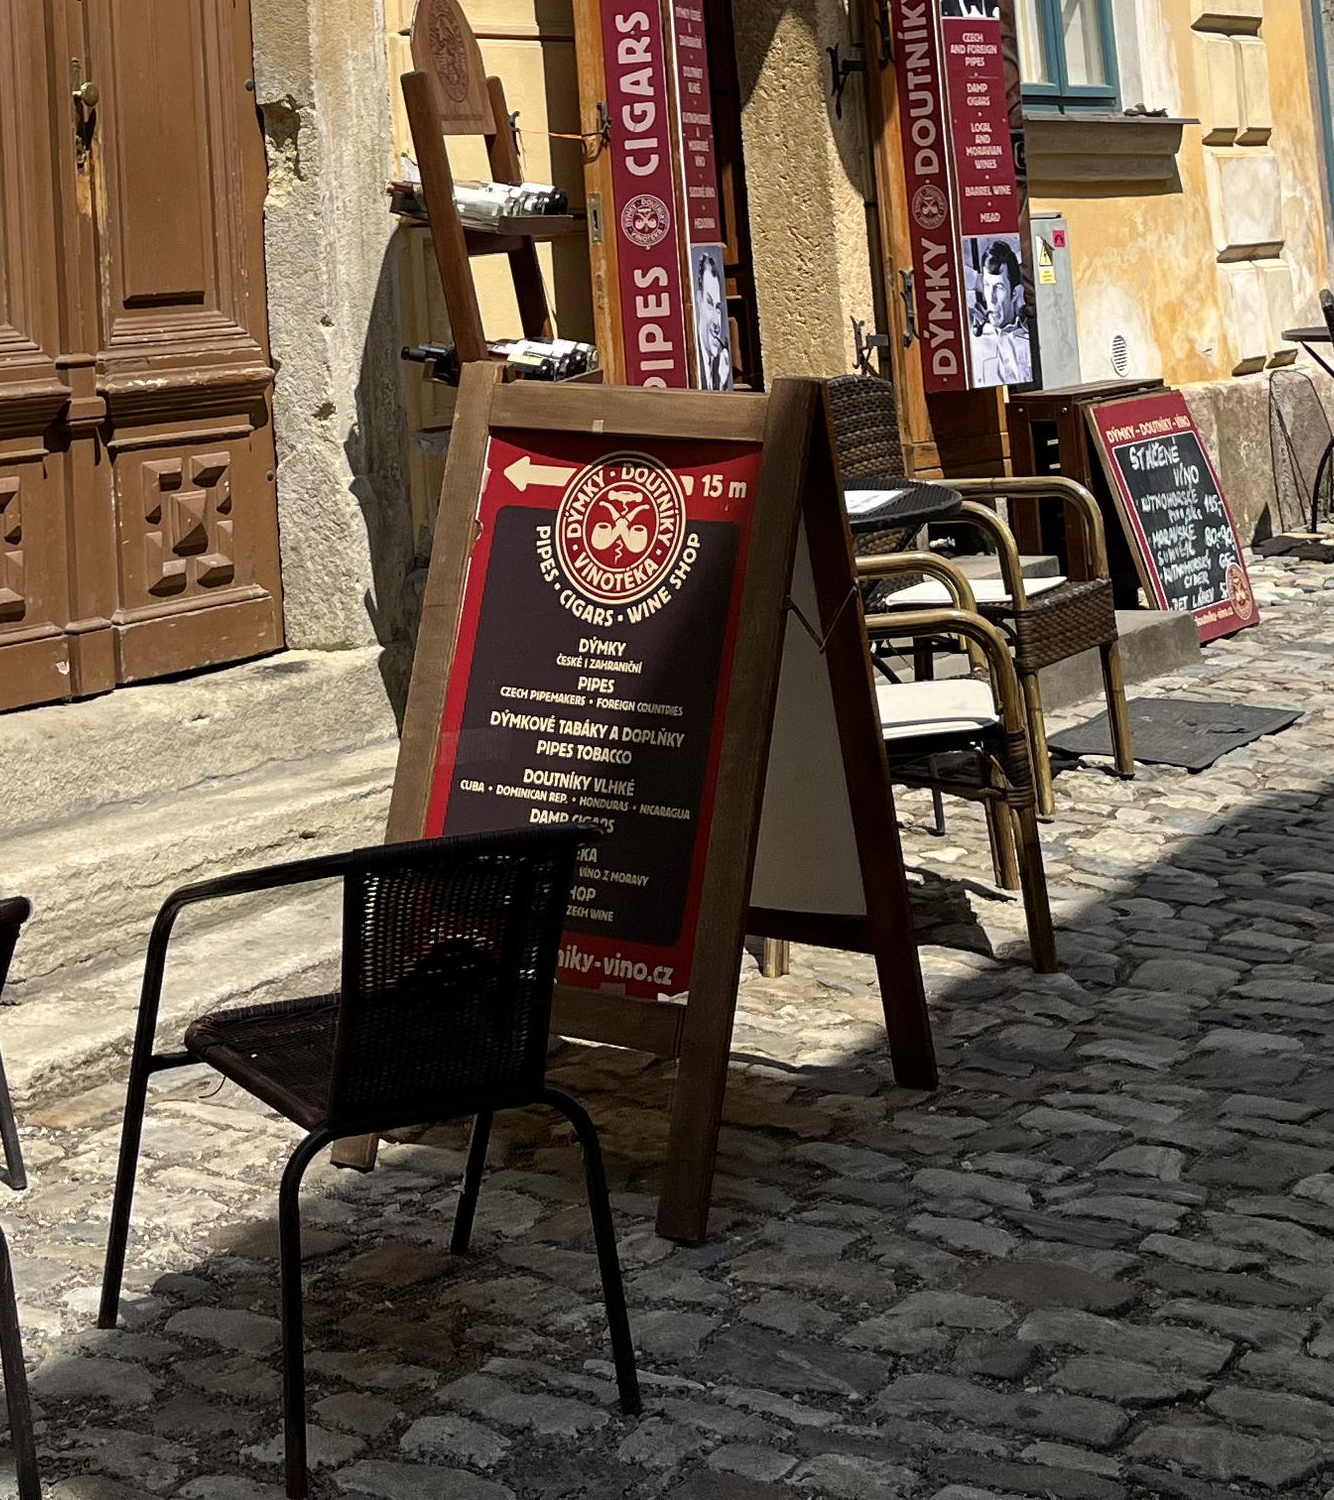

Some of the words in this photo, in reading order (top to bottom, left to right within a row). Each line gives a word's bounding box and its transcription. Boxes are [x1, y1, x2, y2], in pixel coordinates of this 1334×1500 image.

[950, 44, 966, 54] AND
[614, 10, 662, 177] CIGARS
[966, 83, 988, 93] DAMP
[975, 134, 991, 145] AND
[993, 186, 1012, 196] WINE
[980, 213, 1001, 223] MEAD
[920, 237, 958, 376] DÝMKY
[633, 266, 675, 388] PIPES
[1105, 426, 1136, 444] DÝMKY
[700, 473, 725, 499] 15
[727, 480, 748, 500] m
[1172, 461, 1200, 488] VÍNO
[564, 468, 606, 539] DÝMKY
[621, 463, 680, 547] DOUTNÍKY
[535, 525, 560, 584] PIPES
[559, 589, 615, 628] CIGARS
[626, 586, 673, 624] WINE
[669, 532, 701, 590] SHOP
[572, 556, 659, 592] VINOTÉKA
[578, 636, 627, 658] DÝMKY
[556, 653, 583, 668] ČESKÉ
[589, 657, 643, 674] ZAHRANIČNÍ
[577, 676, 616, 694] PIPES
[500, 686, 529, 700] CZECH
[529, 688, 586, 706] PIPEMAKERS
[596, 697, 636, 712] FOREIGN
[636, 702, 684, 717] COUNTRIES
[490, 710, 556, 733] DÝMKOVÉ
[559, 718, 609, 740] TABÁKY
[608, 725, 619, 740] A
[621, 727, 685, 748] DOPLŇKY
[536, 739, 574, 758] PIPES
[576, 744, 633, 765] TOBACCO
[523, 768, 592, 791] DOUTNÍKY
[593, 777, 636, 797] VLHKÉ
[460, 779, 485, 793] CUBA
[495, 784, 548, 802] DOMINICAN
[548, 790, 569, 805] REP.
[579, 795, 629, 812] HONDURAS
[639, 803, 691, 820] NICARAGUA
[610, 870, 650, 888] MORAVY
[569, 885, 597, 902] HOP
[566, 904, 589, 918] ZECH
[589, 909, 615, 923] WINE
